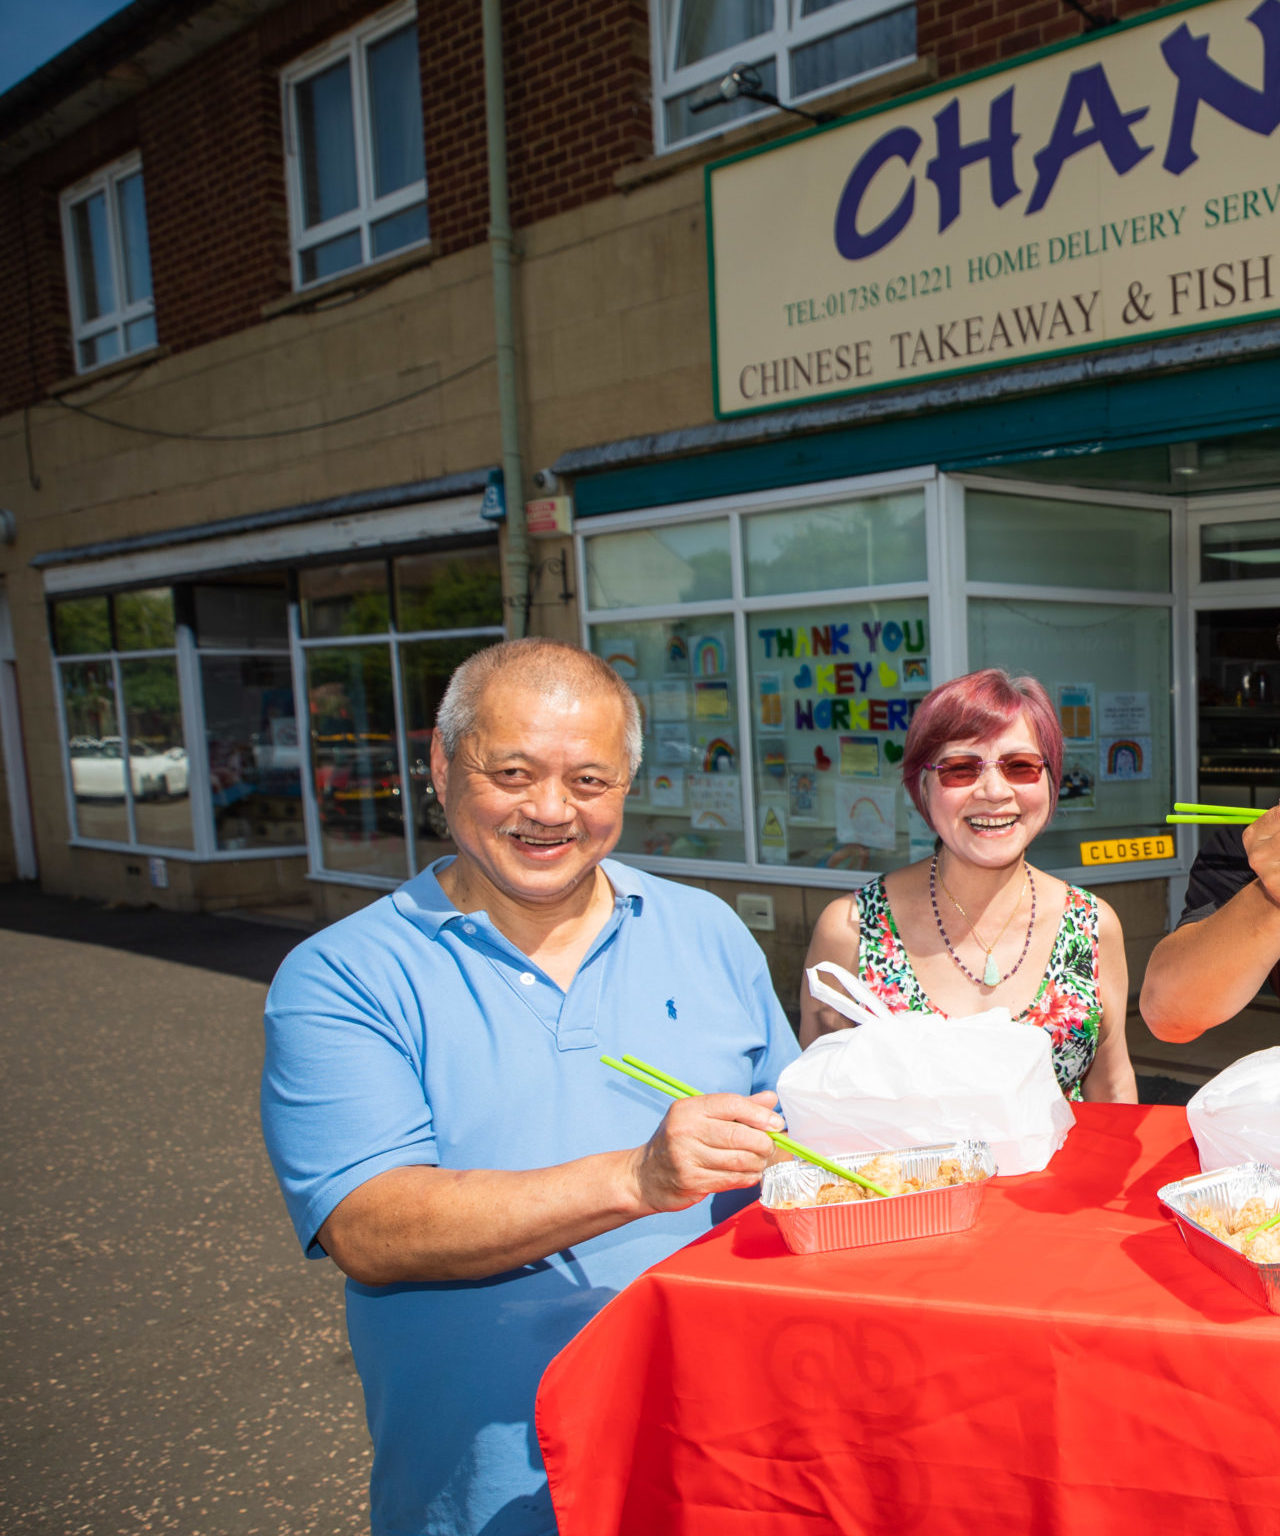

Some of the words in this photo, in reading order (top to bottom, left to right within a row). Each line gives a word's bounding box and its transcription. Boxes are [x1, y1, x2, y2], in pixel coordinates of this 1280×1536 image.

[784, 282, 882, 327] TEL:01738
[886, 265, 953, 302] 621221
[967, 243, 1041, 284] HOME
[1047, 206, 1187, 264] DELIVERY
[739, 340, 873, 400] CHINESE
[890, 290, 1101, 369] TAKEAWAY
[1121, 280, 1156, 325] &
[1168, 254, 1273, 316] FISH
[758, 623, 849, 659] THANK
[862, 619, 925, 653] YOU
[815, 662, 872, 695] KEY
[1090, 840, 1165, 861] CLOSED
